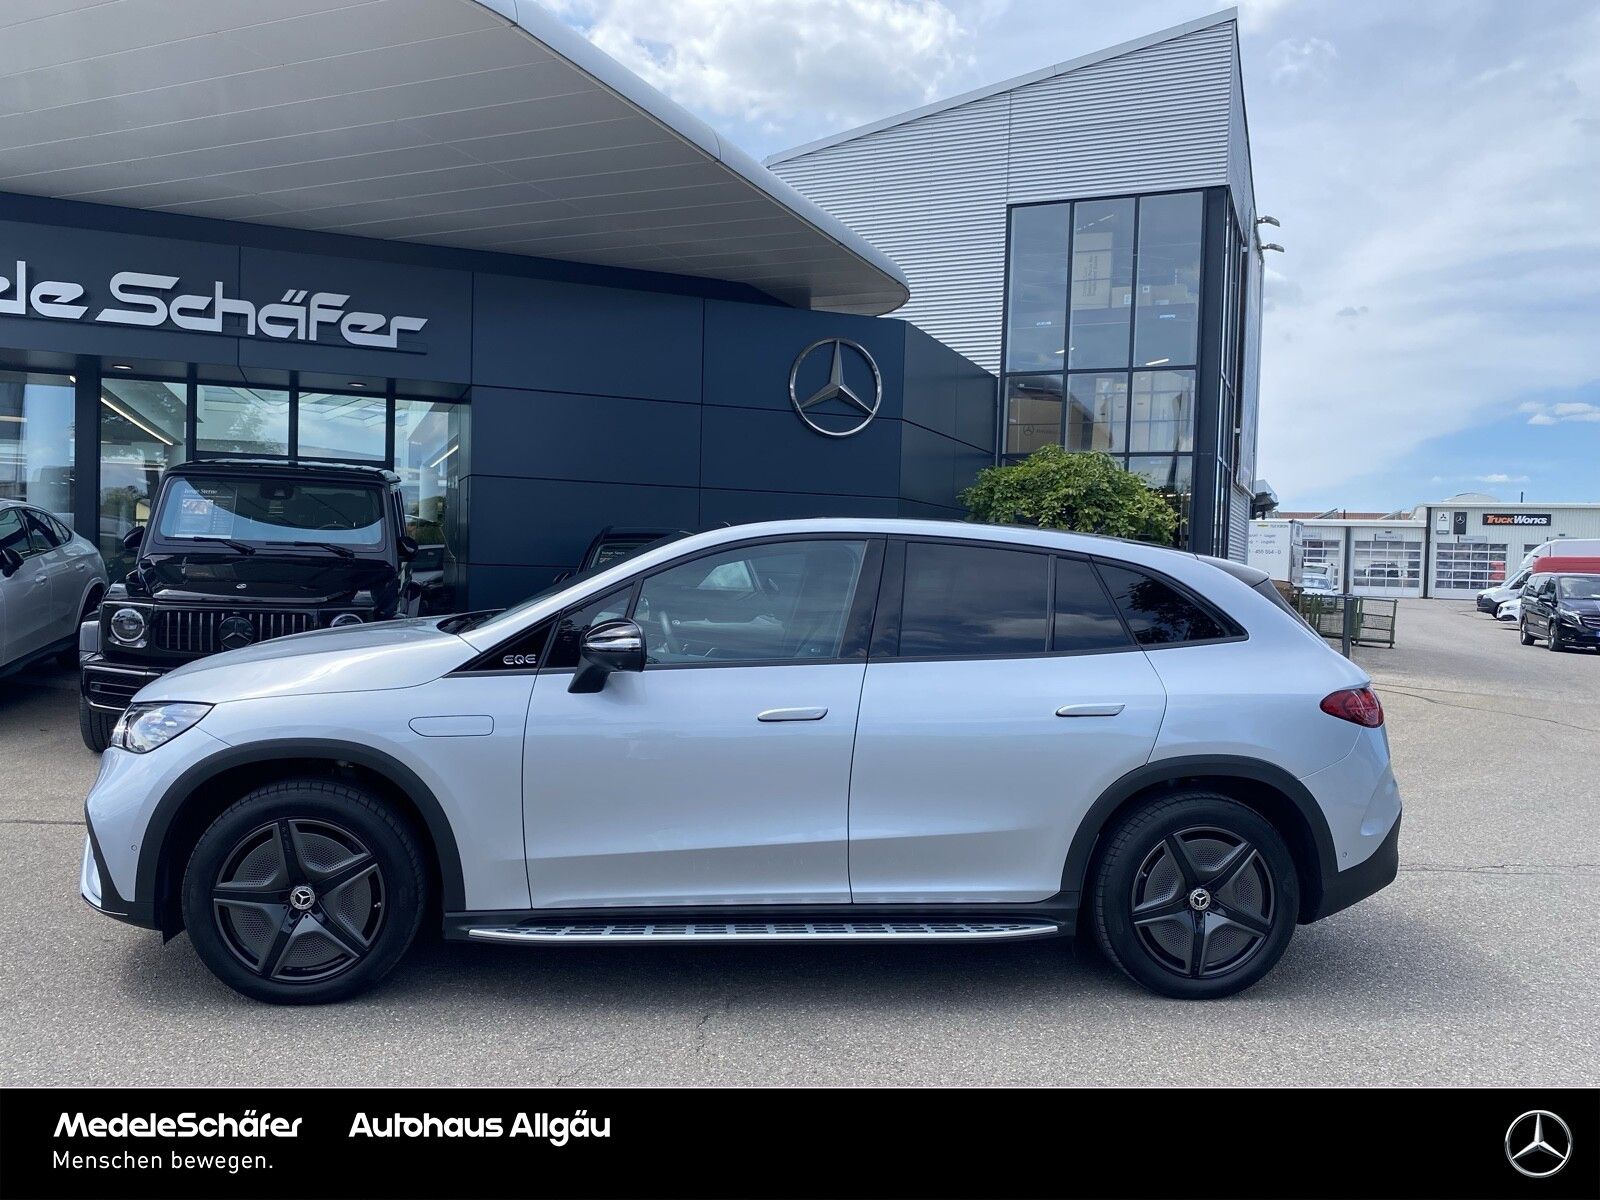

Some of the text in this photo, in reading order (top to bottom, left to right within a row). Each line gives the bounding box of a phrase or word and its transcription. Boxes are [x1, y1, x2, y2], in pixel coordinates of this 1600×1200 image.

[95, 271, 429, 349] Schäfer
[1486, 514, 1548, 525] TruckWorks
[502, 653, 537, 665] EQE
